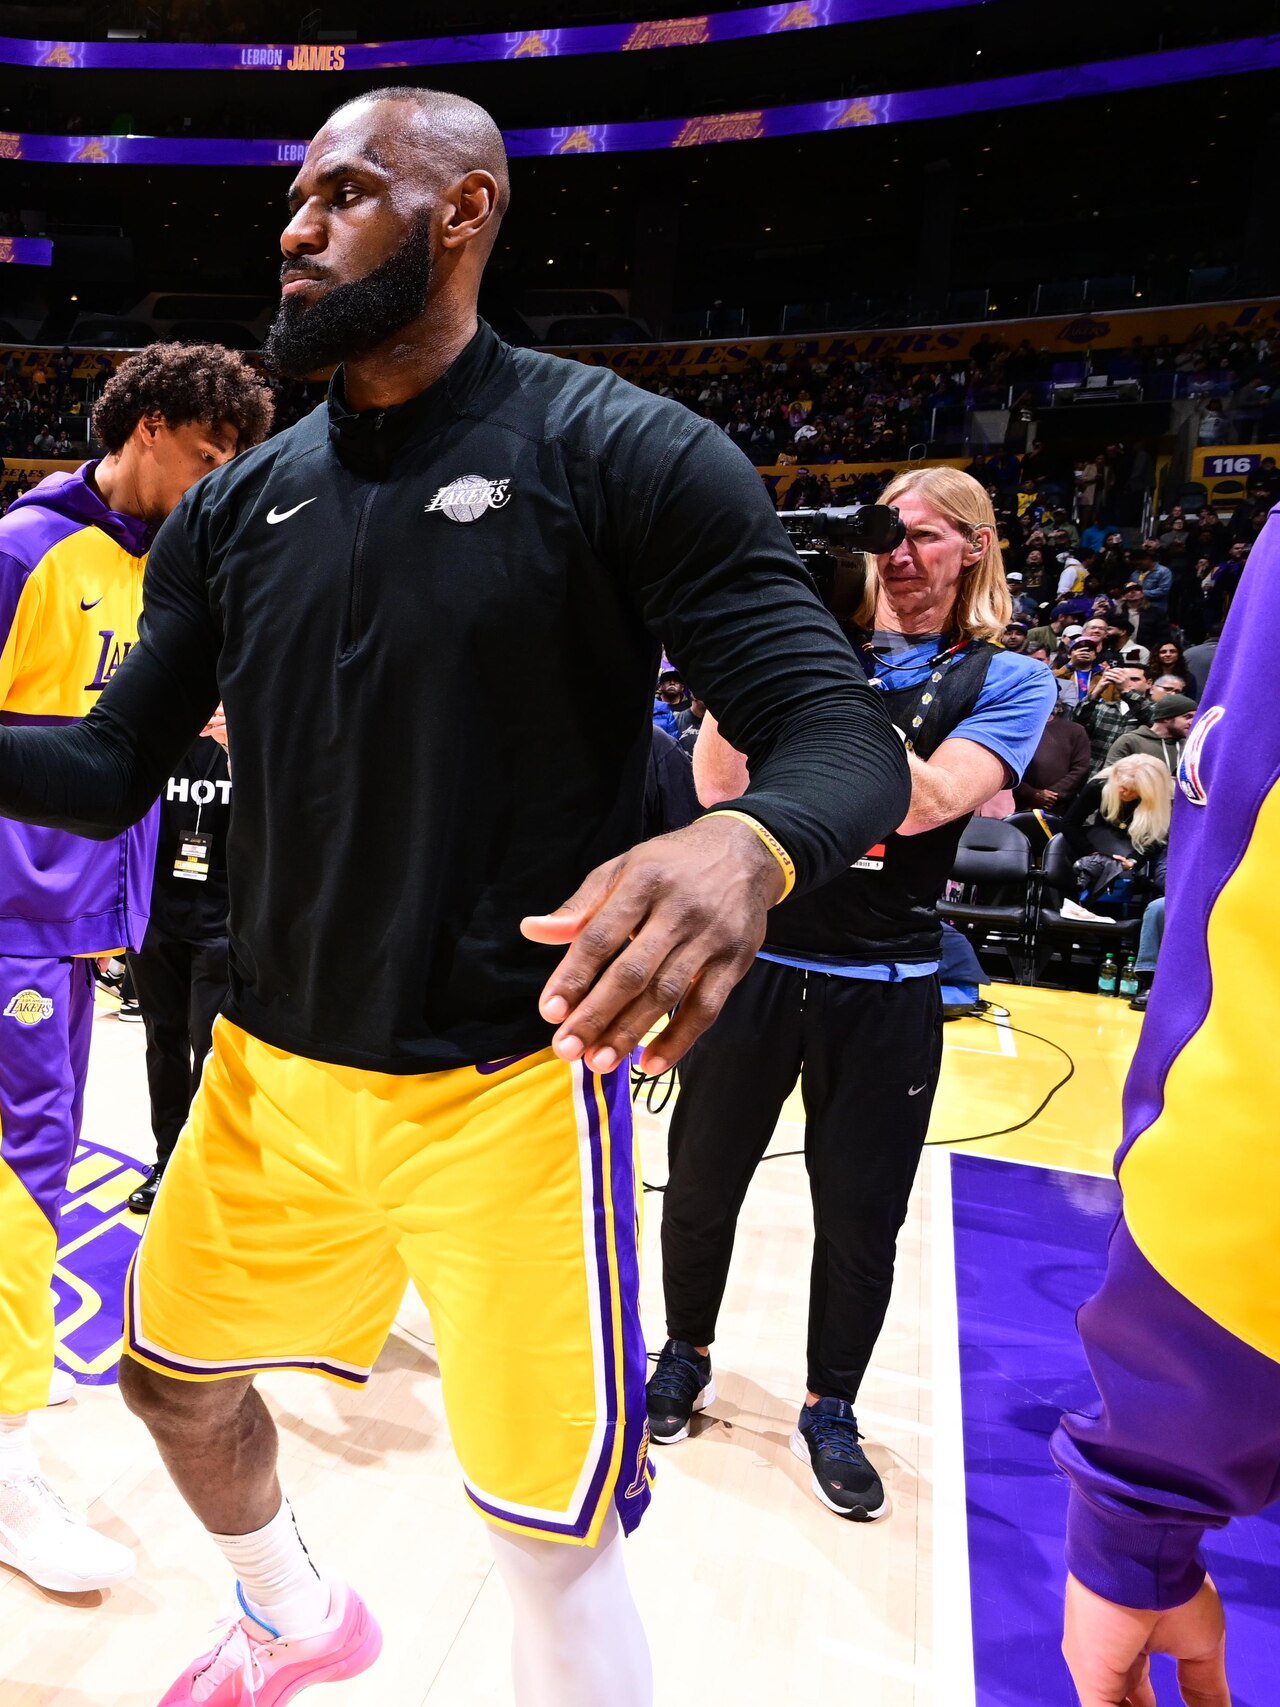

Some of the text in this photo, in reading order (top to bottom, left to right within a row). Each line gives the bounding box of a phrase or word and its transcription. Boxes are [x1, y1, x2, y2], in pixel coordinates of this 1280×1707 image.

[241, 46, 346, 71] LEBRON JAMES
[278, 144, 309, 161] LEBR
[570, 344, 752, 367] NGELES
[1212, 457, 1252, 474] 116
[424, 485, 511, 513] LAKERS
[167, 776, 232, 806] HOT
[6, 998, 53, 1017] LAKERS
